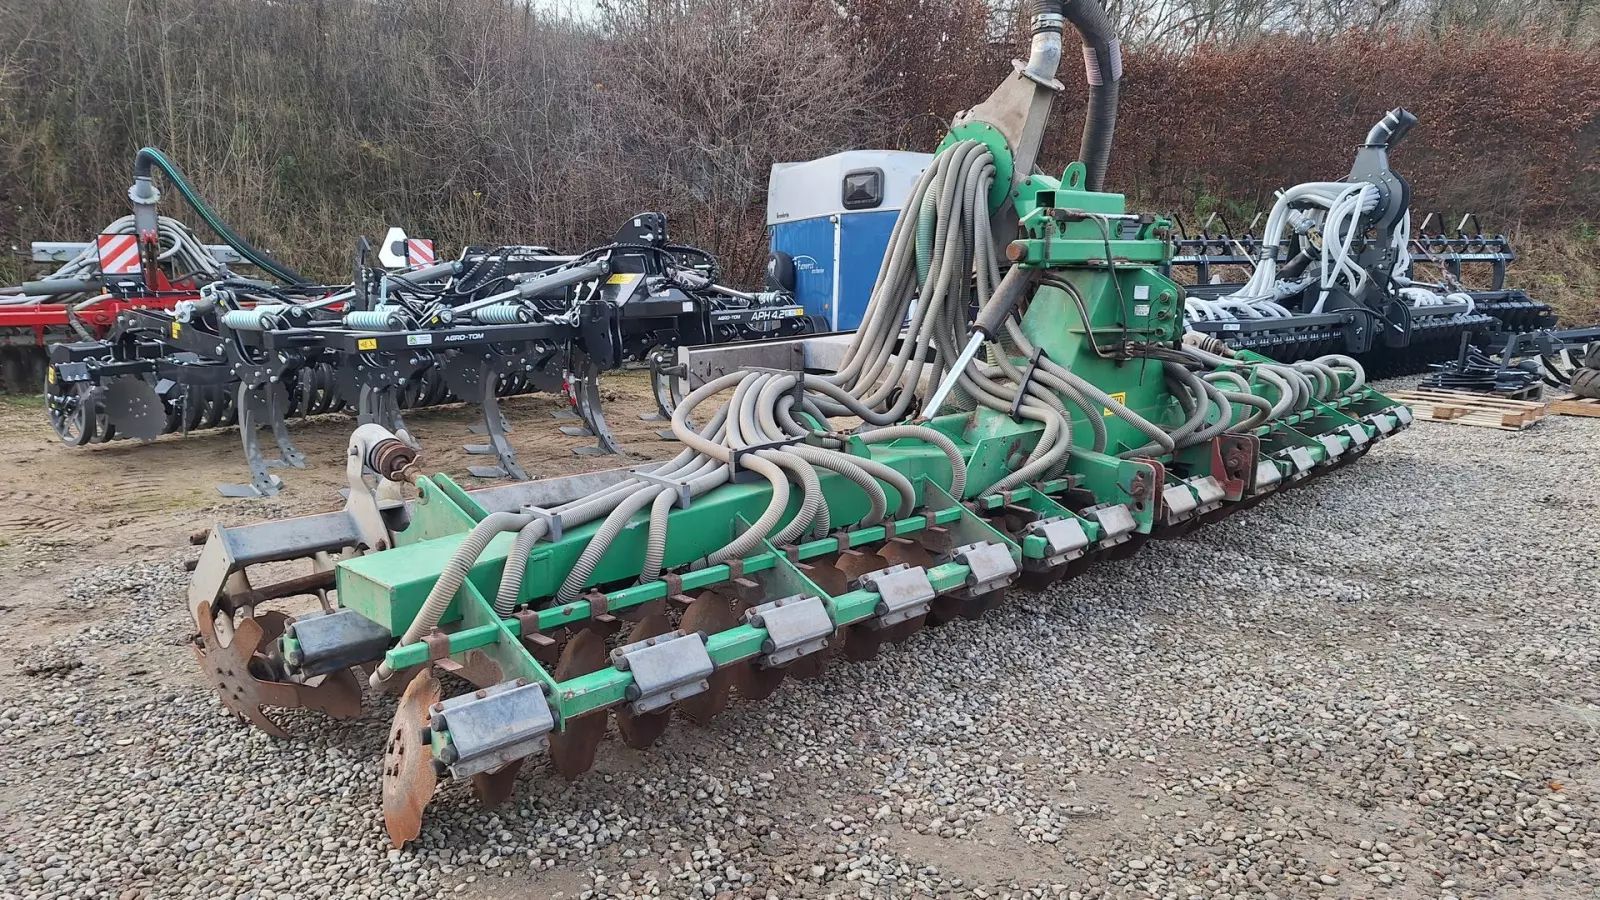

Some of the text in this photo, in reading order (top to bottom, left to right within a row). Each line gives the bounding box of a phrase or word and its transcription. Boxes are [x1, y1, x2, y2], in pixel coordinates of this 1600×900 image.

[751, 311, 770, 321] APH
[771, 310, 785, 319] 4.2
[444, 333, 485, 342] AGRO-TOM
